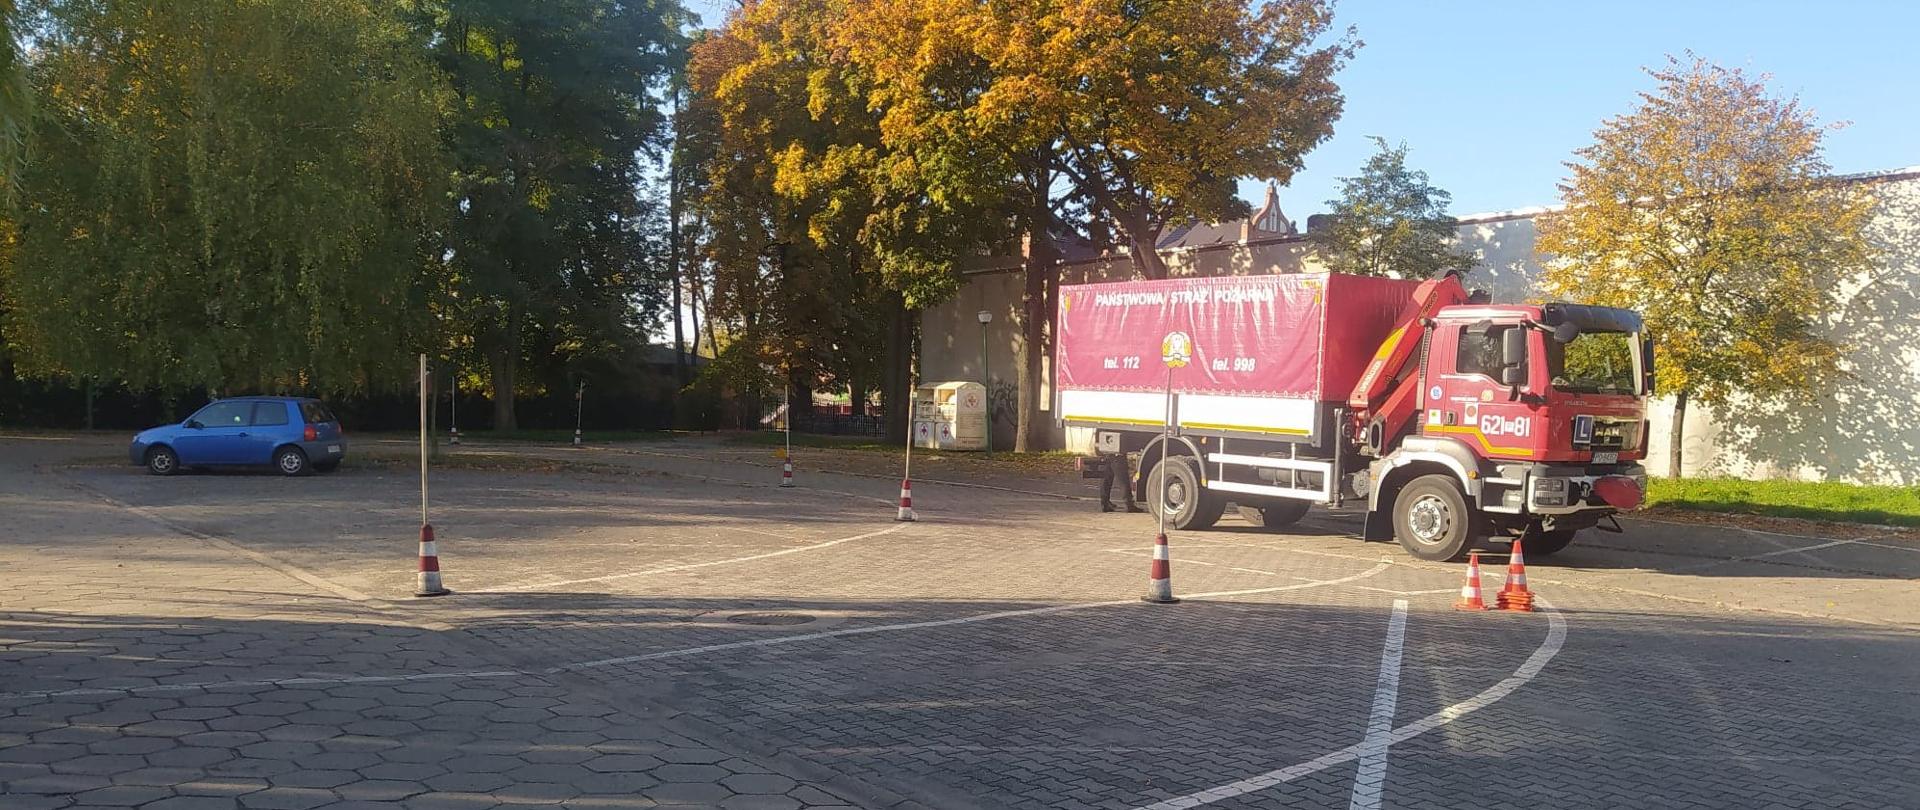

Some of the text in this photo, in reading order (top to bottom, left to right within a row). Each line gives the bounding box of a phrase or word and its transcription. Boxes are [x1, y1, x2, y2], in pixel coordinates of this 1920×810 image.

[1104, 357, 1140, 369] tel. 112
[1212, 358, 1256, 372] tel. 998
[1481, 414, 1505, 435] 621
[1514, 416, 1531, 437] 81
[1580, 420, 1588, 437] L
